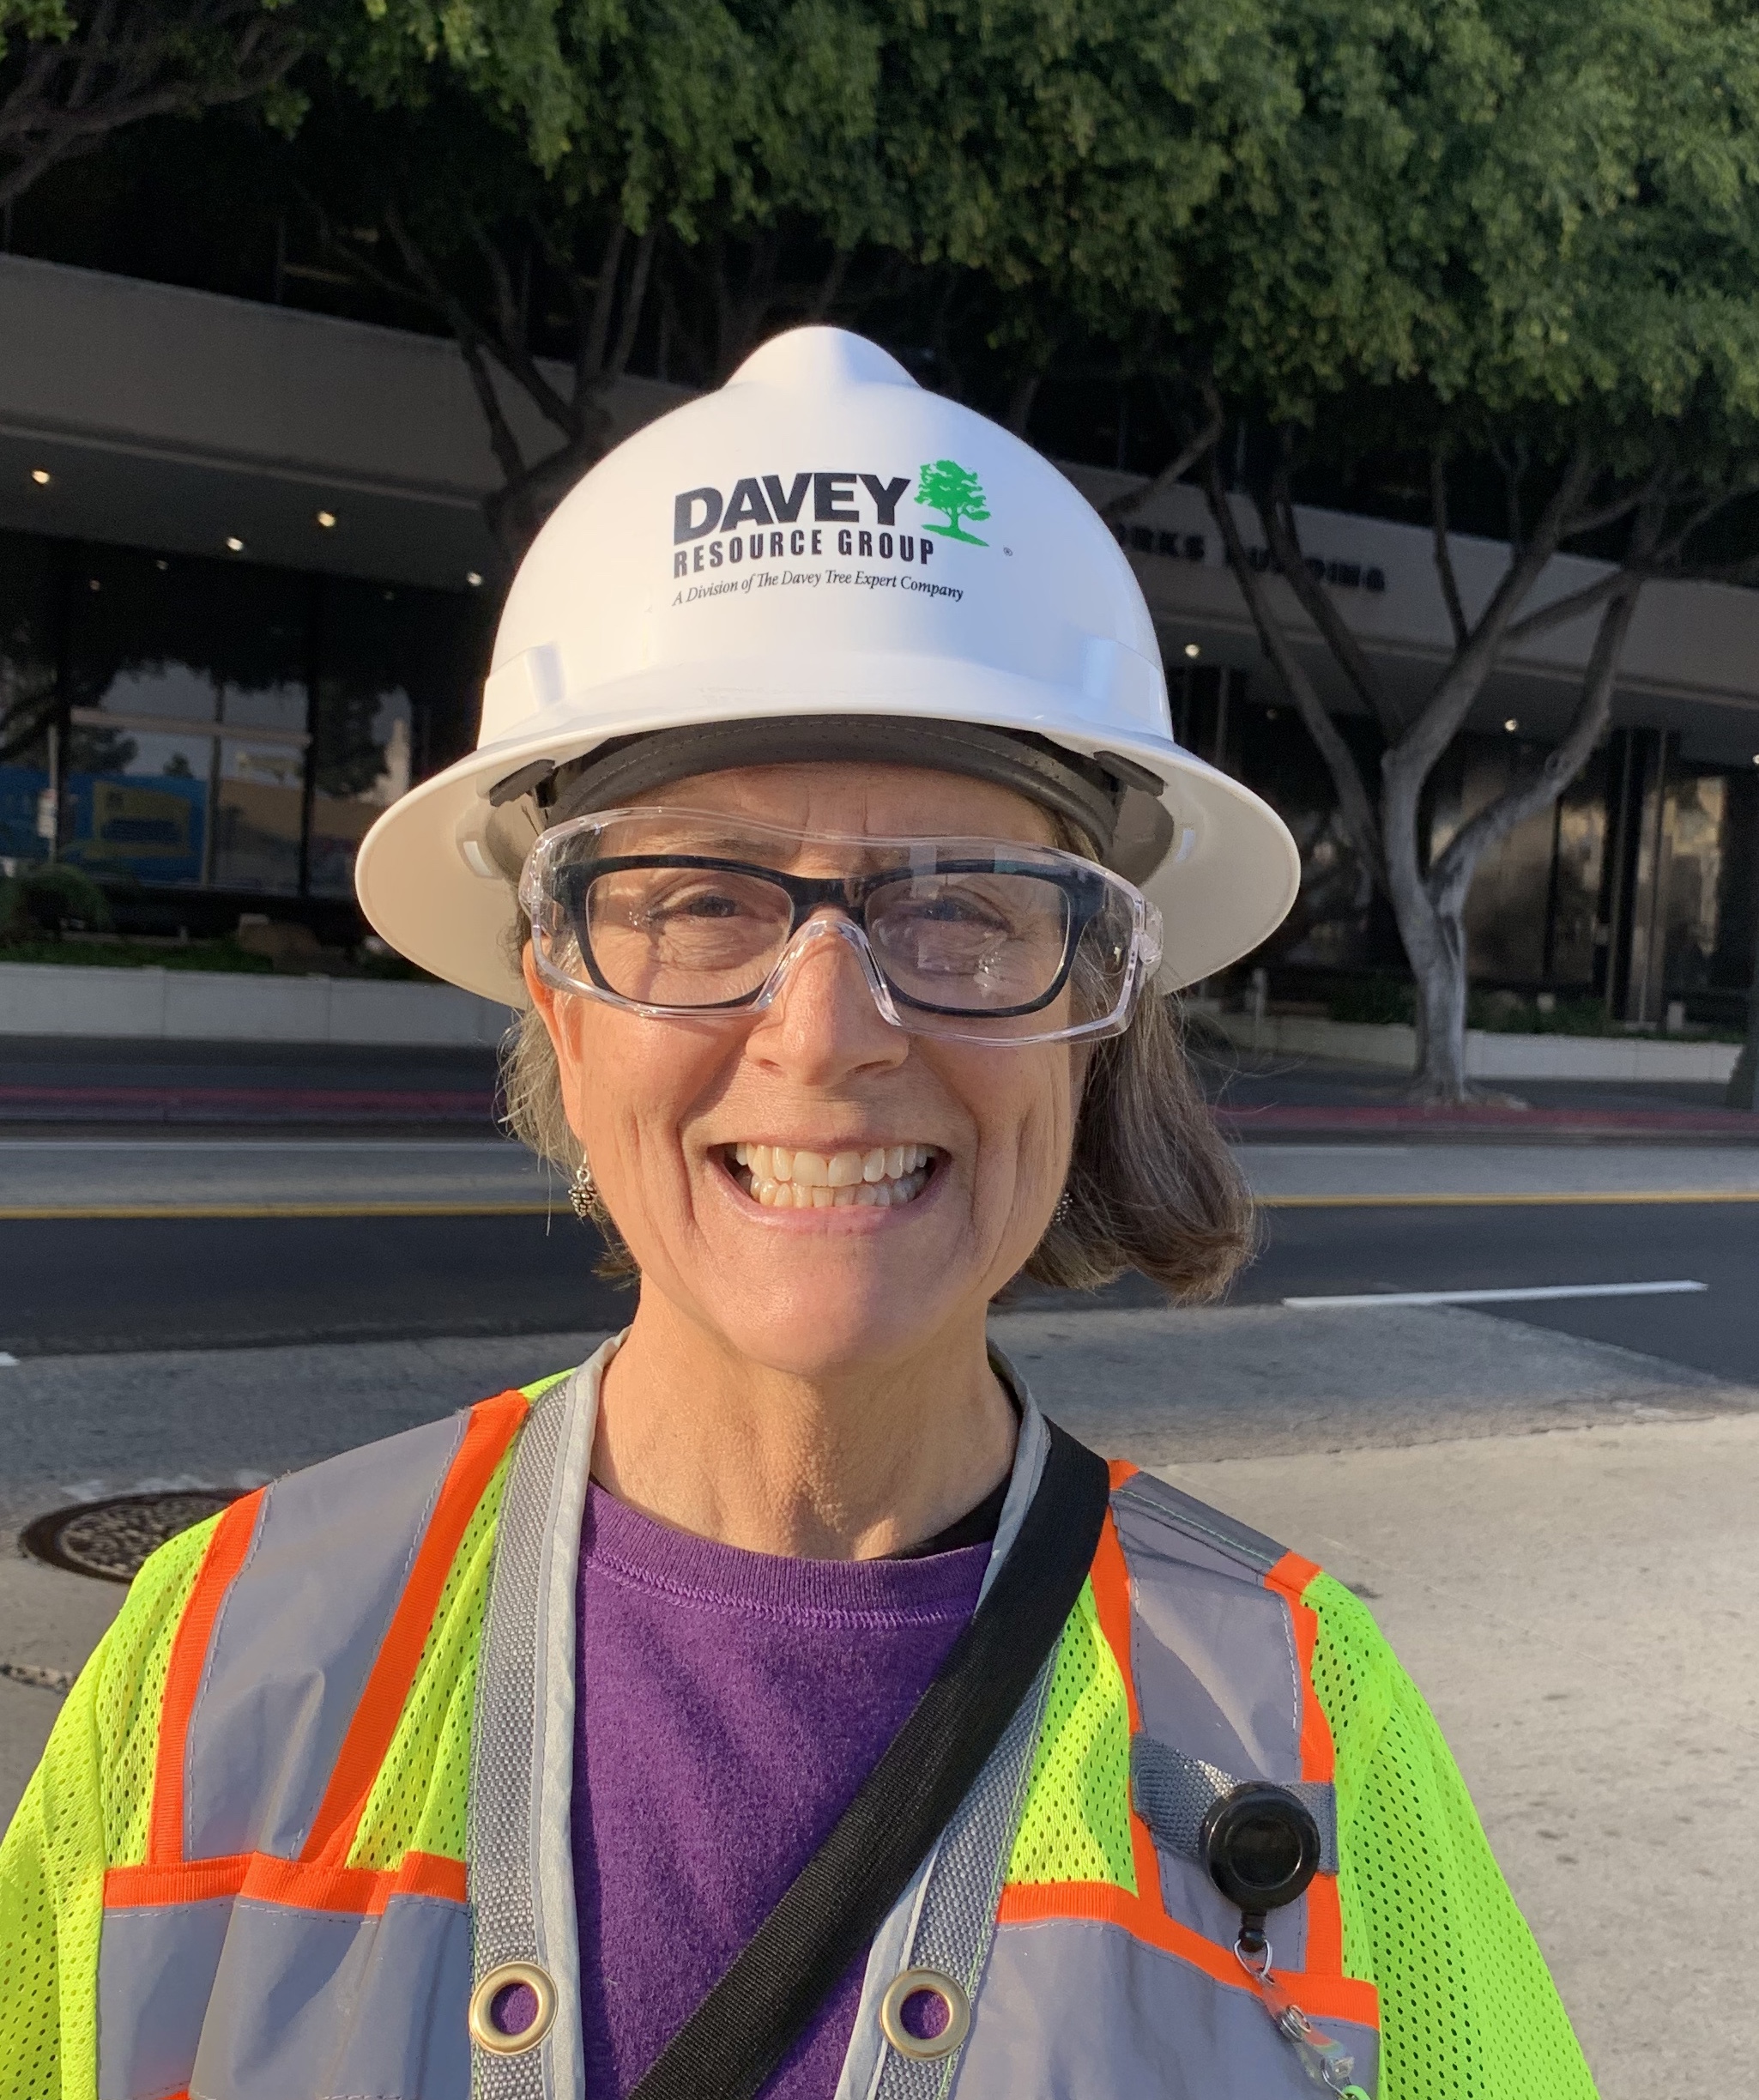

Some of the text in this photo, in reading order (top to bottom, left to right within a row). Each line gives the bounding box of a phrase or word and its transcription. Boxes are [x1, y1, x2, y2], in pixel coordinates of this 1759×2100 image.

[673, 472, 911, 546] DAVEY
[674, 529, 934, 579] RESOURCE GROUP
[672, 569, 964, 607] A Division of The Davey Tree Expert Company
